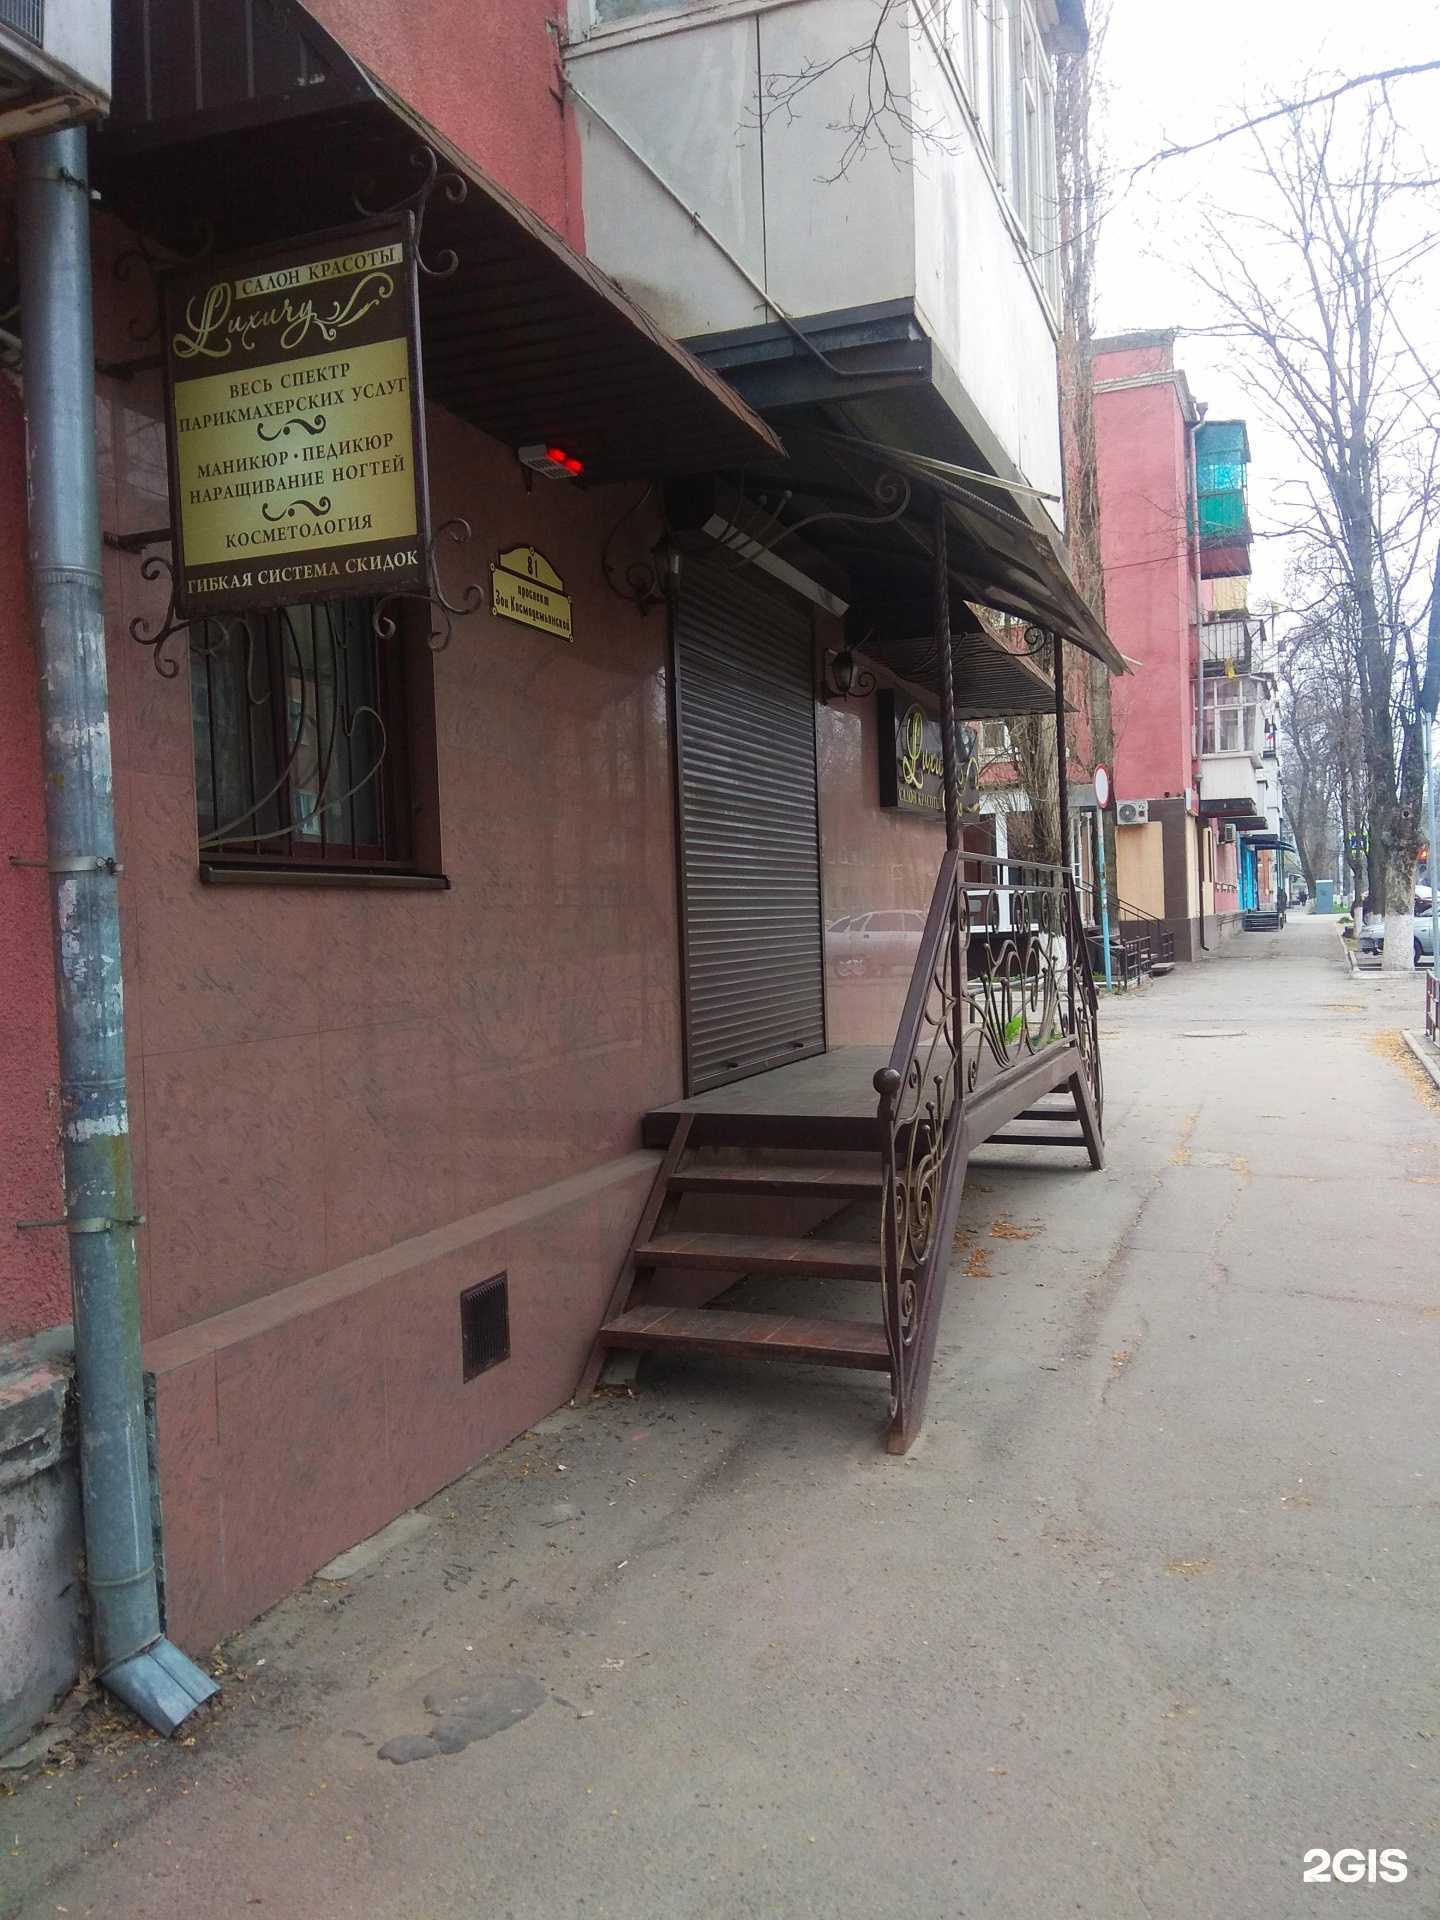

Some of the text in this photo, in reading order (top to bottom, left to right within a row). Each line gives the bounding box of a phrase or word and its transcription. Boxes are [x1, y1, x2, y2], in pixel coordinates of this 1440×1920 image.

[242, 246, 396, 296] САЛОН КРАСОТЫ
[173, 282, 314, 358] Luxury
[229, 362, 351, 399] ВЕСЬ СПЕКТР
[179, 377, 408, 433] ПАРИКМАХЕРСКИХ УСЛУГ
[190, 454, 405, 504] НАРАЩИВАНИЕ НОГТЕЙ
[197, 432, 394, 480] МАНИКЮР ПЕДИКЮР
[225, 514, 373, 549] КОСМЕТОЛОГИЯ
[187, 550, 418, 595] ГИБКАЯ СИСТЕМА СКИДОК
[527, 556, 538, 578] 81
